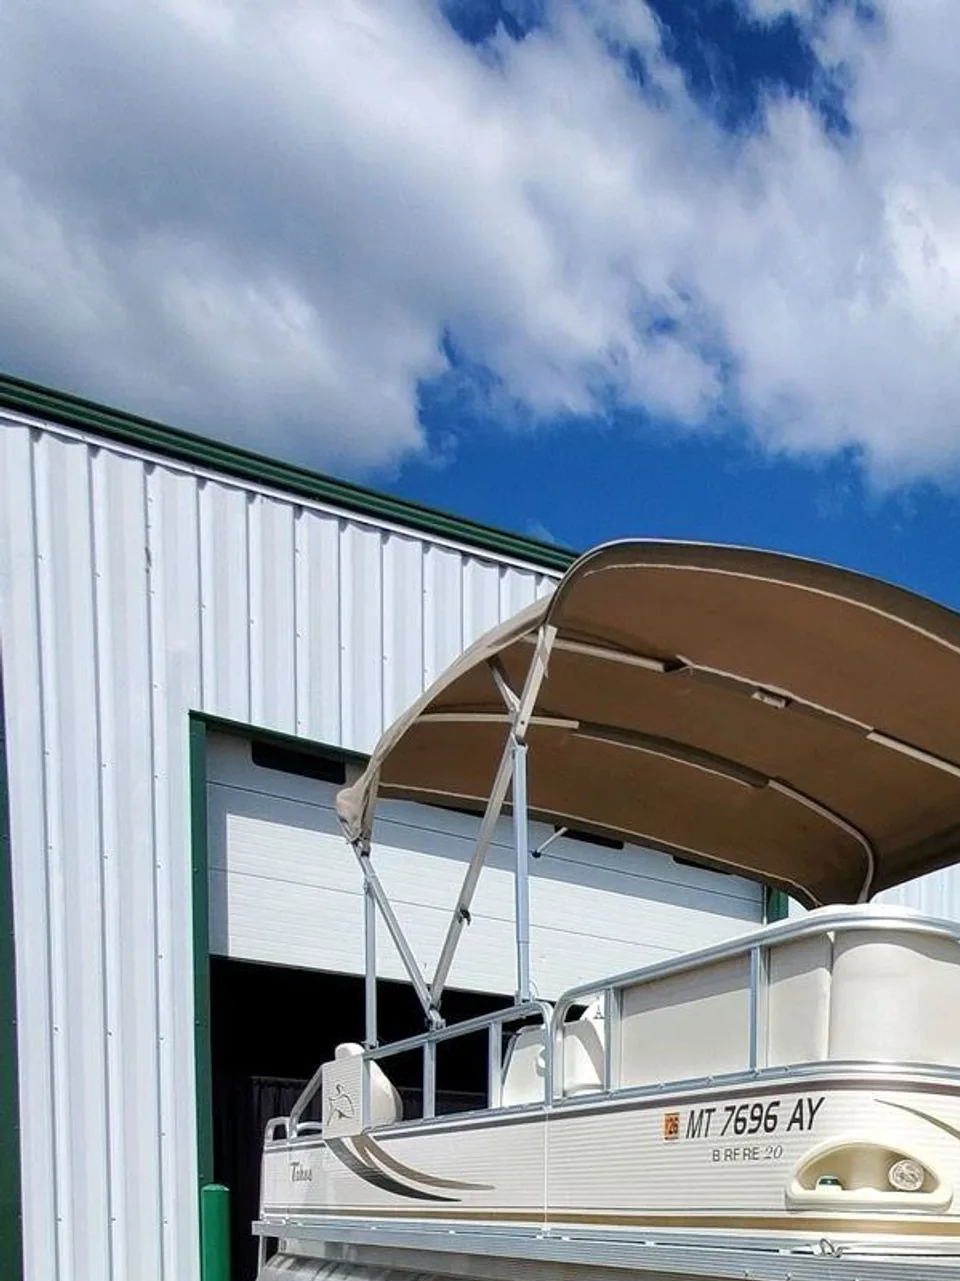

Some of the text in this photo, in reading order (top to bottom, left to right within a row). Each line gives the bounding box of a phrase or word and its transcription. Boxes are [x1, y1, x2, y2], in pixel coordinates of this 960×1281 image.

[685, 1097, 826, 1139] MT 7696 AY
